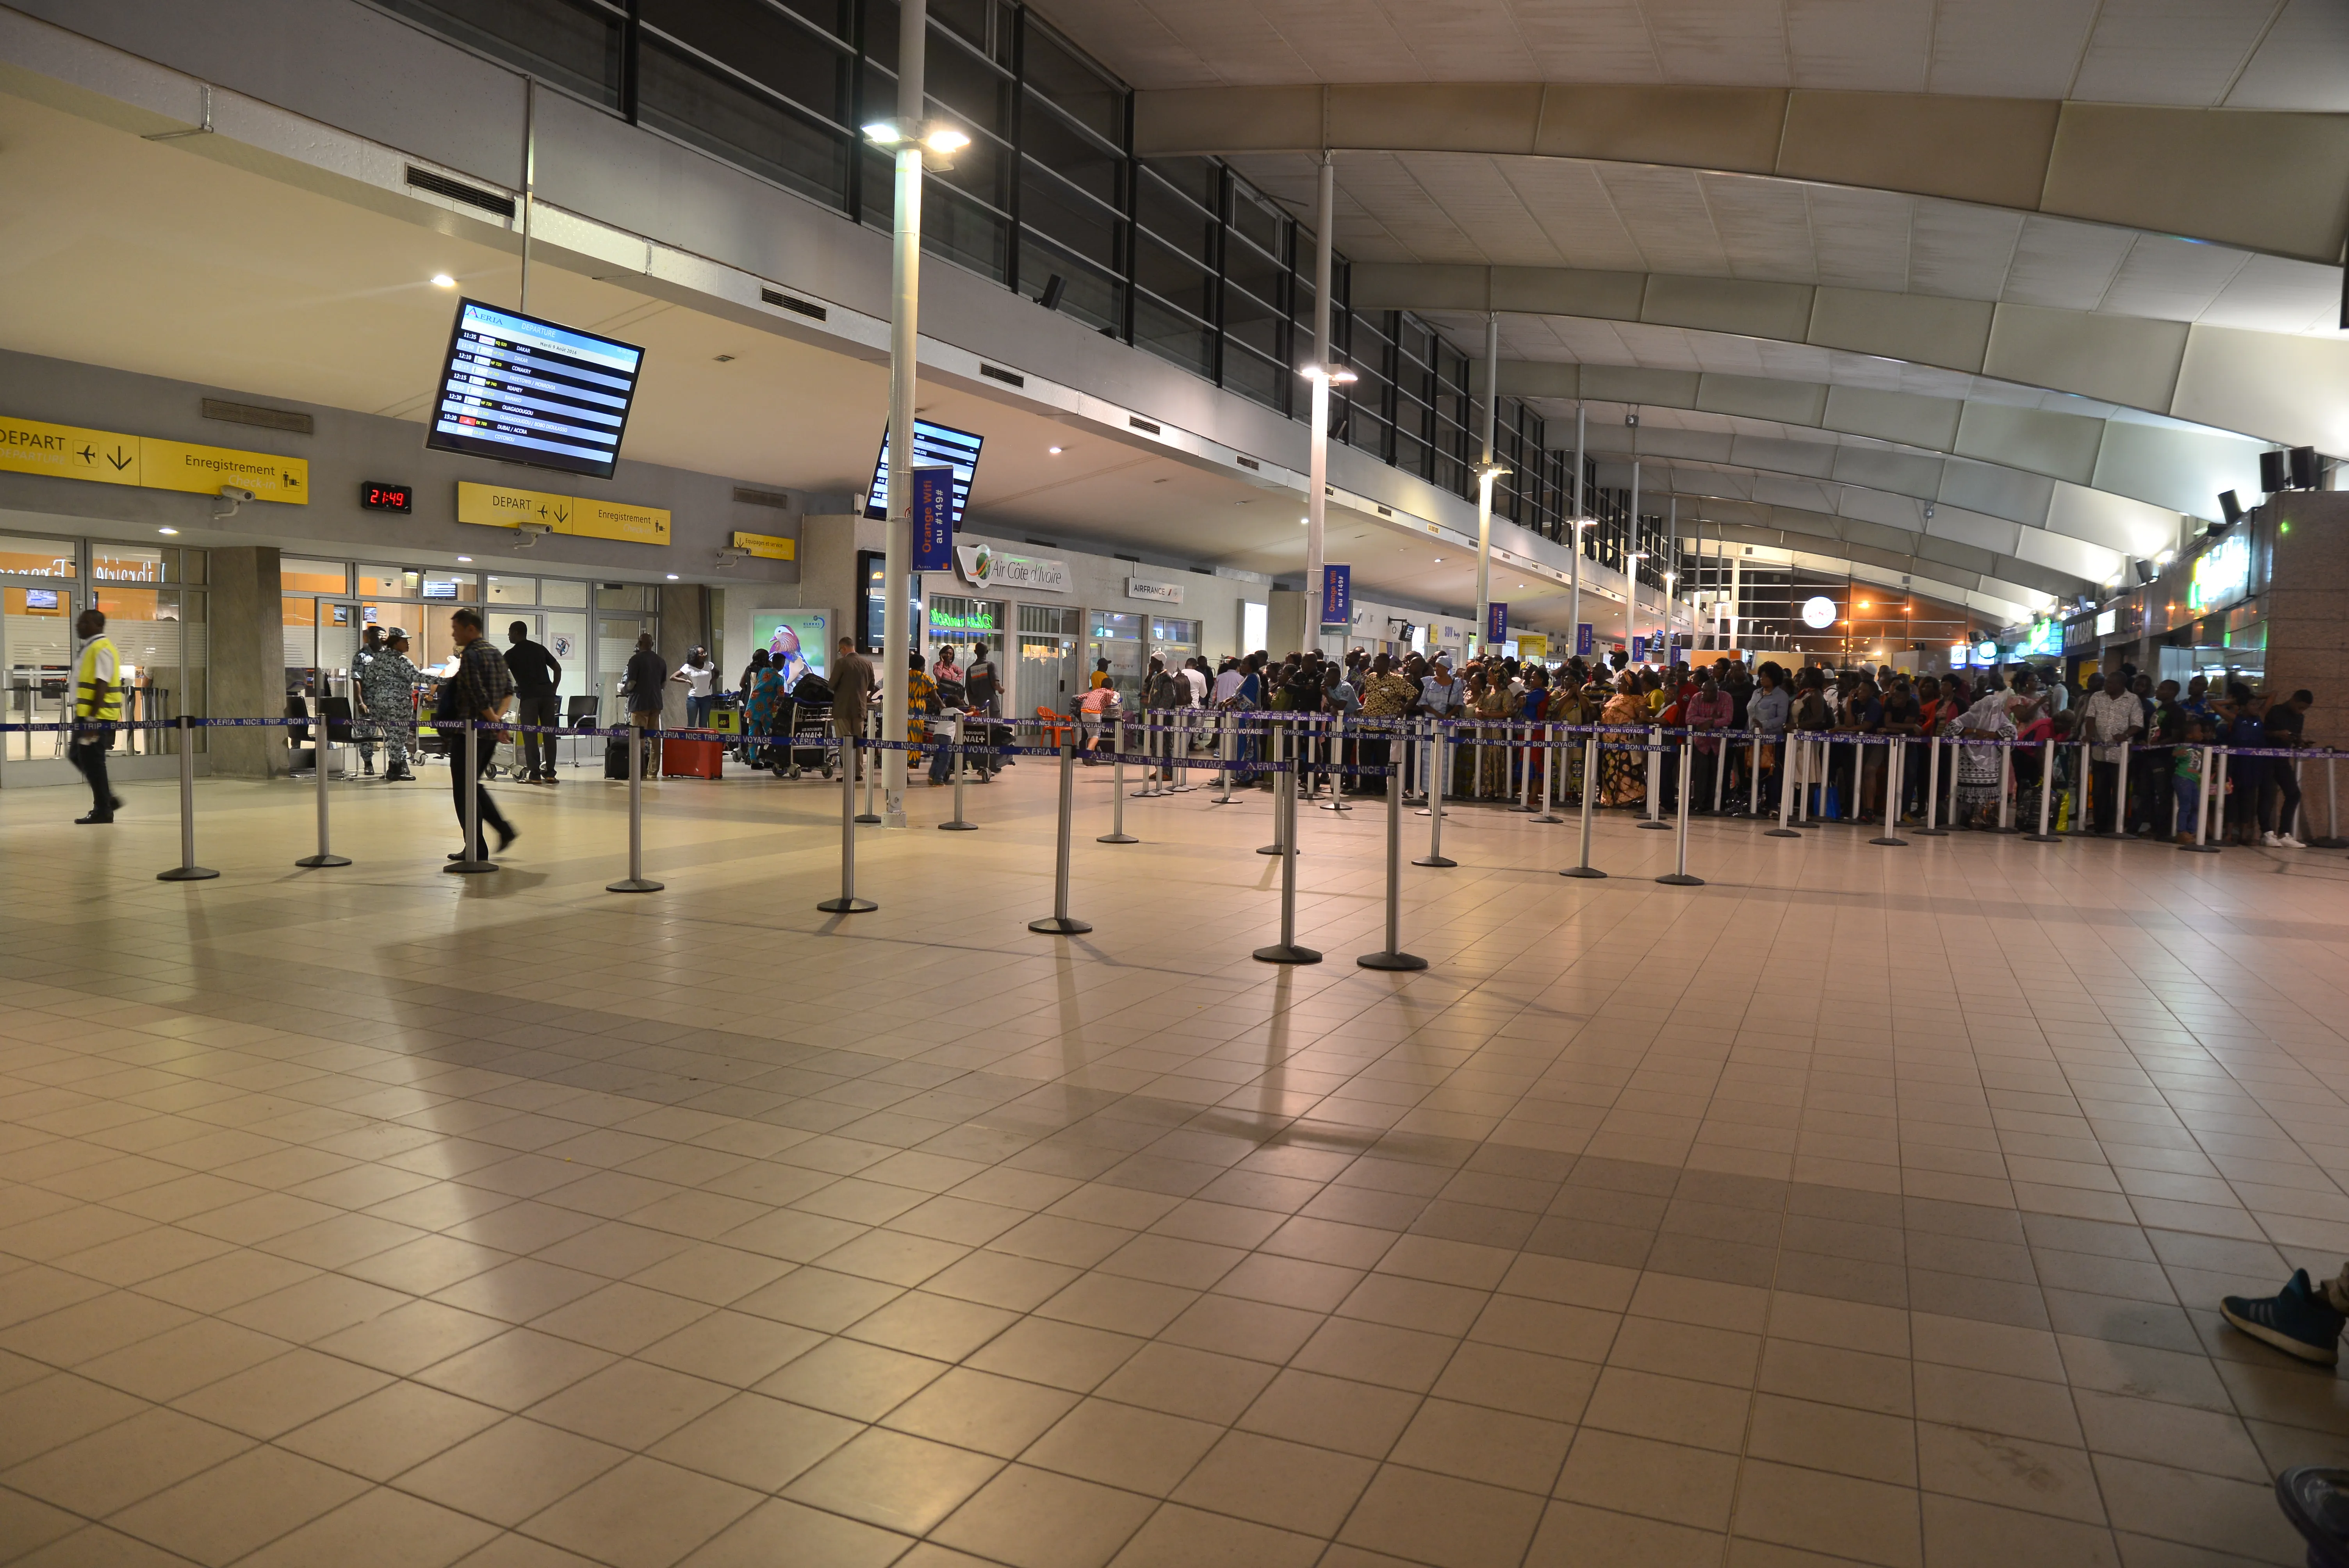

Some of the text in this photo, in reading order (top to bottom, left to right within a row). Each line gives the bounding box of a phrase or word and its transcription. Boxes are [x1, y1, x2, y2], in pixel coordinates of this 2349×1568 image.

[465, 307, 503, 325] AERIA
[521, 323, 556, 338] DEPARTURE
[512, 365, 531, 374] CONAKRY
[509, 375, 531, 385] FREETOWN
[535, 381, 556, 390] MONROVIA
[502, 404, 534, 416] OUAGADOUGOU
[499, 415, 531, 426] OUAGADOUGOU
[545, 424, 568, 433] DIOULASSO
[0, 429, 66, 451] DEPART
[494, 434, 515, 442] COTONOU
[186, 455, 275, 476] Enregistrement
[228, 474, 276, 490] Check-in
[370, 489, 404, 506] 21:49
[492, 495, 531, 510] DEPART
[598, 510, 651, 524] Enregistrement
[922, 480, 934, 552] Orange Wifi
[935, 489, 943, 544] au #149#
[623, 524, 651, 534] Check-in
[745, 538, 765, 546] Equipages
[991, 560, 1061, 584] Air Côte d'Ivoire
[1134, 584, 1165, 595] AIRFRANCE
[1329, 586, 1337, 612] Orange
[1338, 599, 1343, 607] au
[1445, 626, 1453, 638] SDV
[743, 736, 772, 744] VOYAGE
[967, 746, 1000, 754] VOYAGE
[1146, 757, 1164, 765] TRIP
[1192, 759, 1226, 769] VOYAGE
[1358, 766, 1381, 774] NICE
